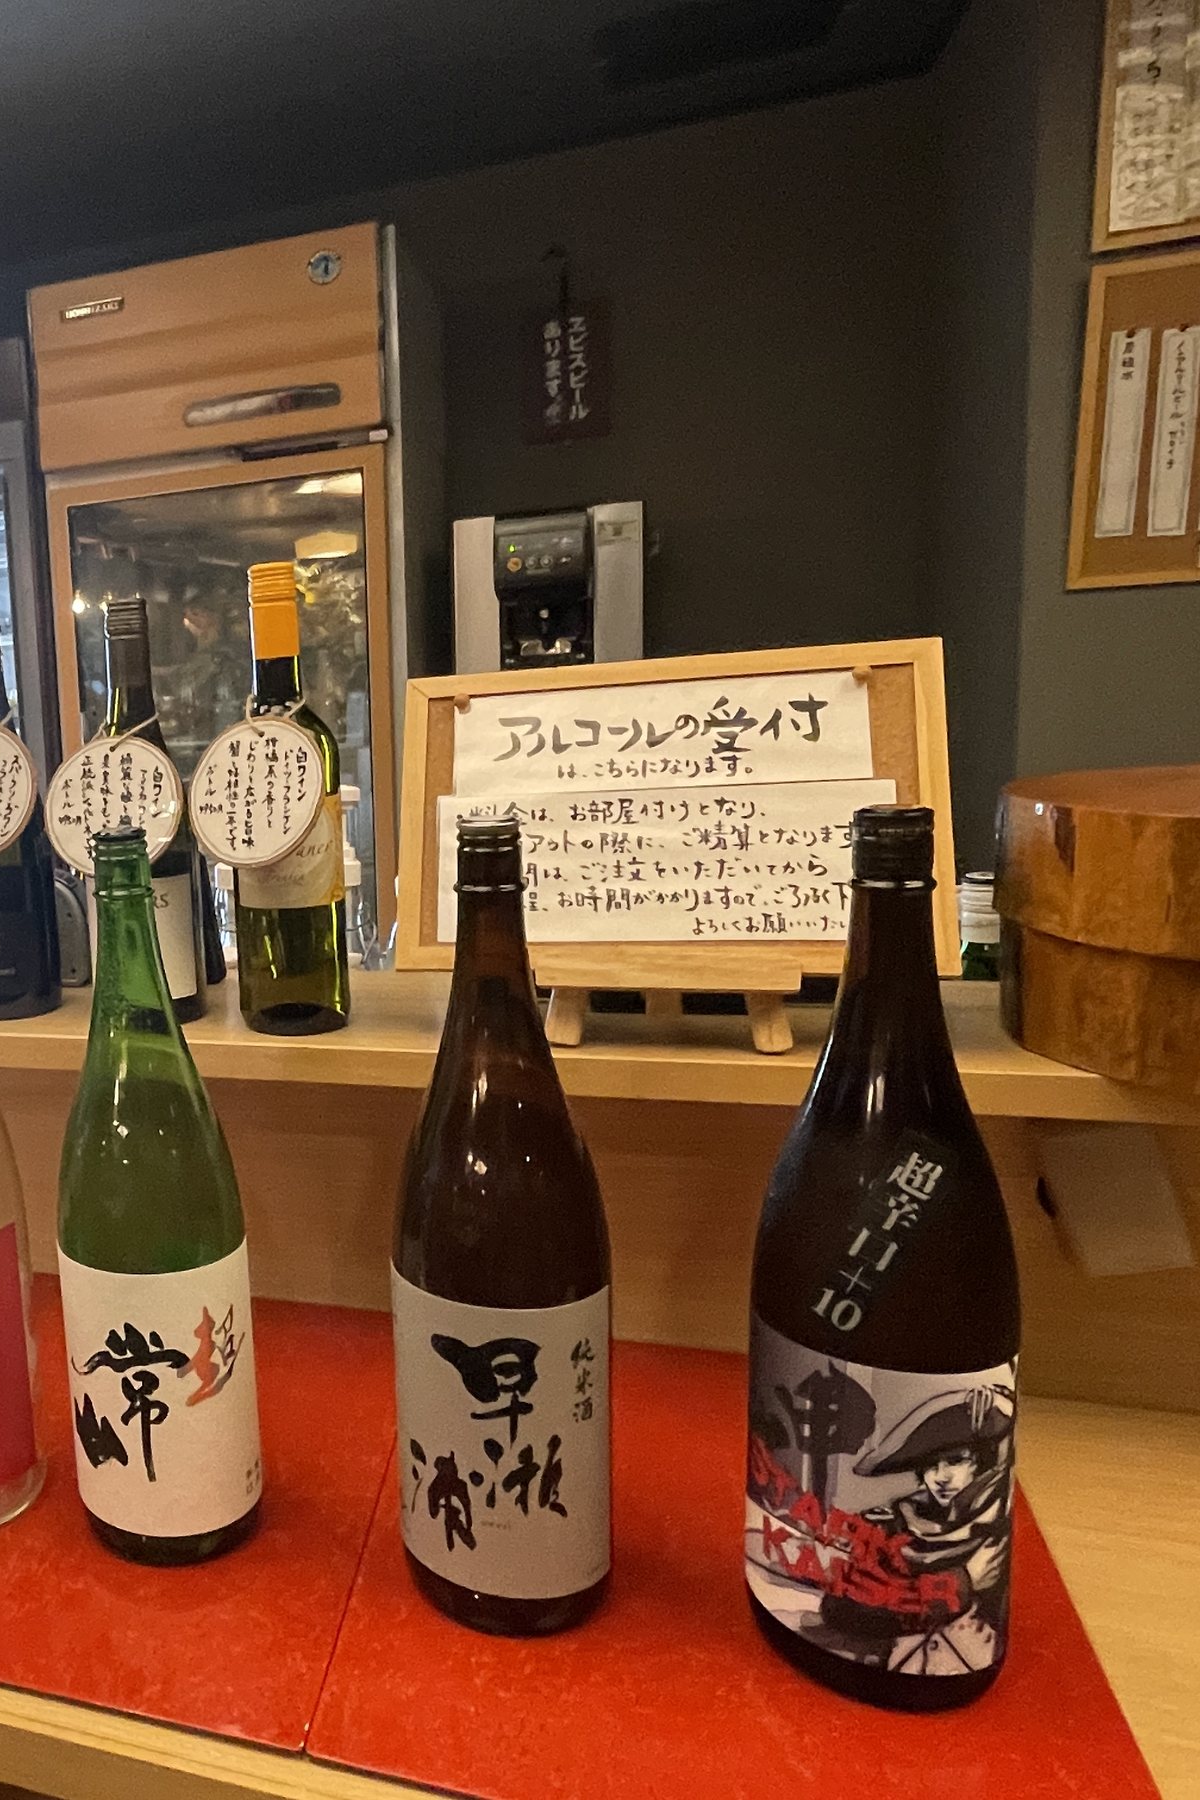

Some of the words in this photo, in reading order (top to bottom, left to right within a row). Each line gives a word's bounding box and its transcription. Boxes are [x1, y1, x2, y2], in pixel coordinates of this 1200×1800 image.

[493, 693, 829, 764] アルコールの受付
[296, 746, 308, 802] 白ワイン
[570, 1337, 595, 1423] 純米酒
